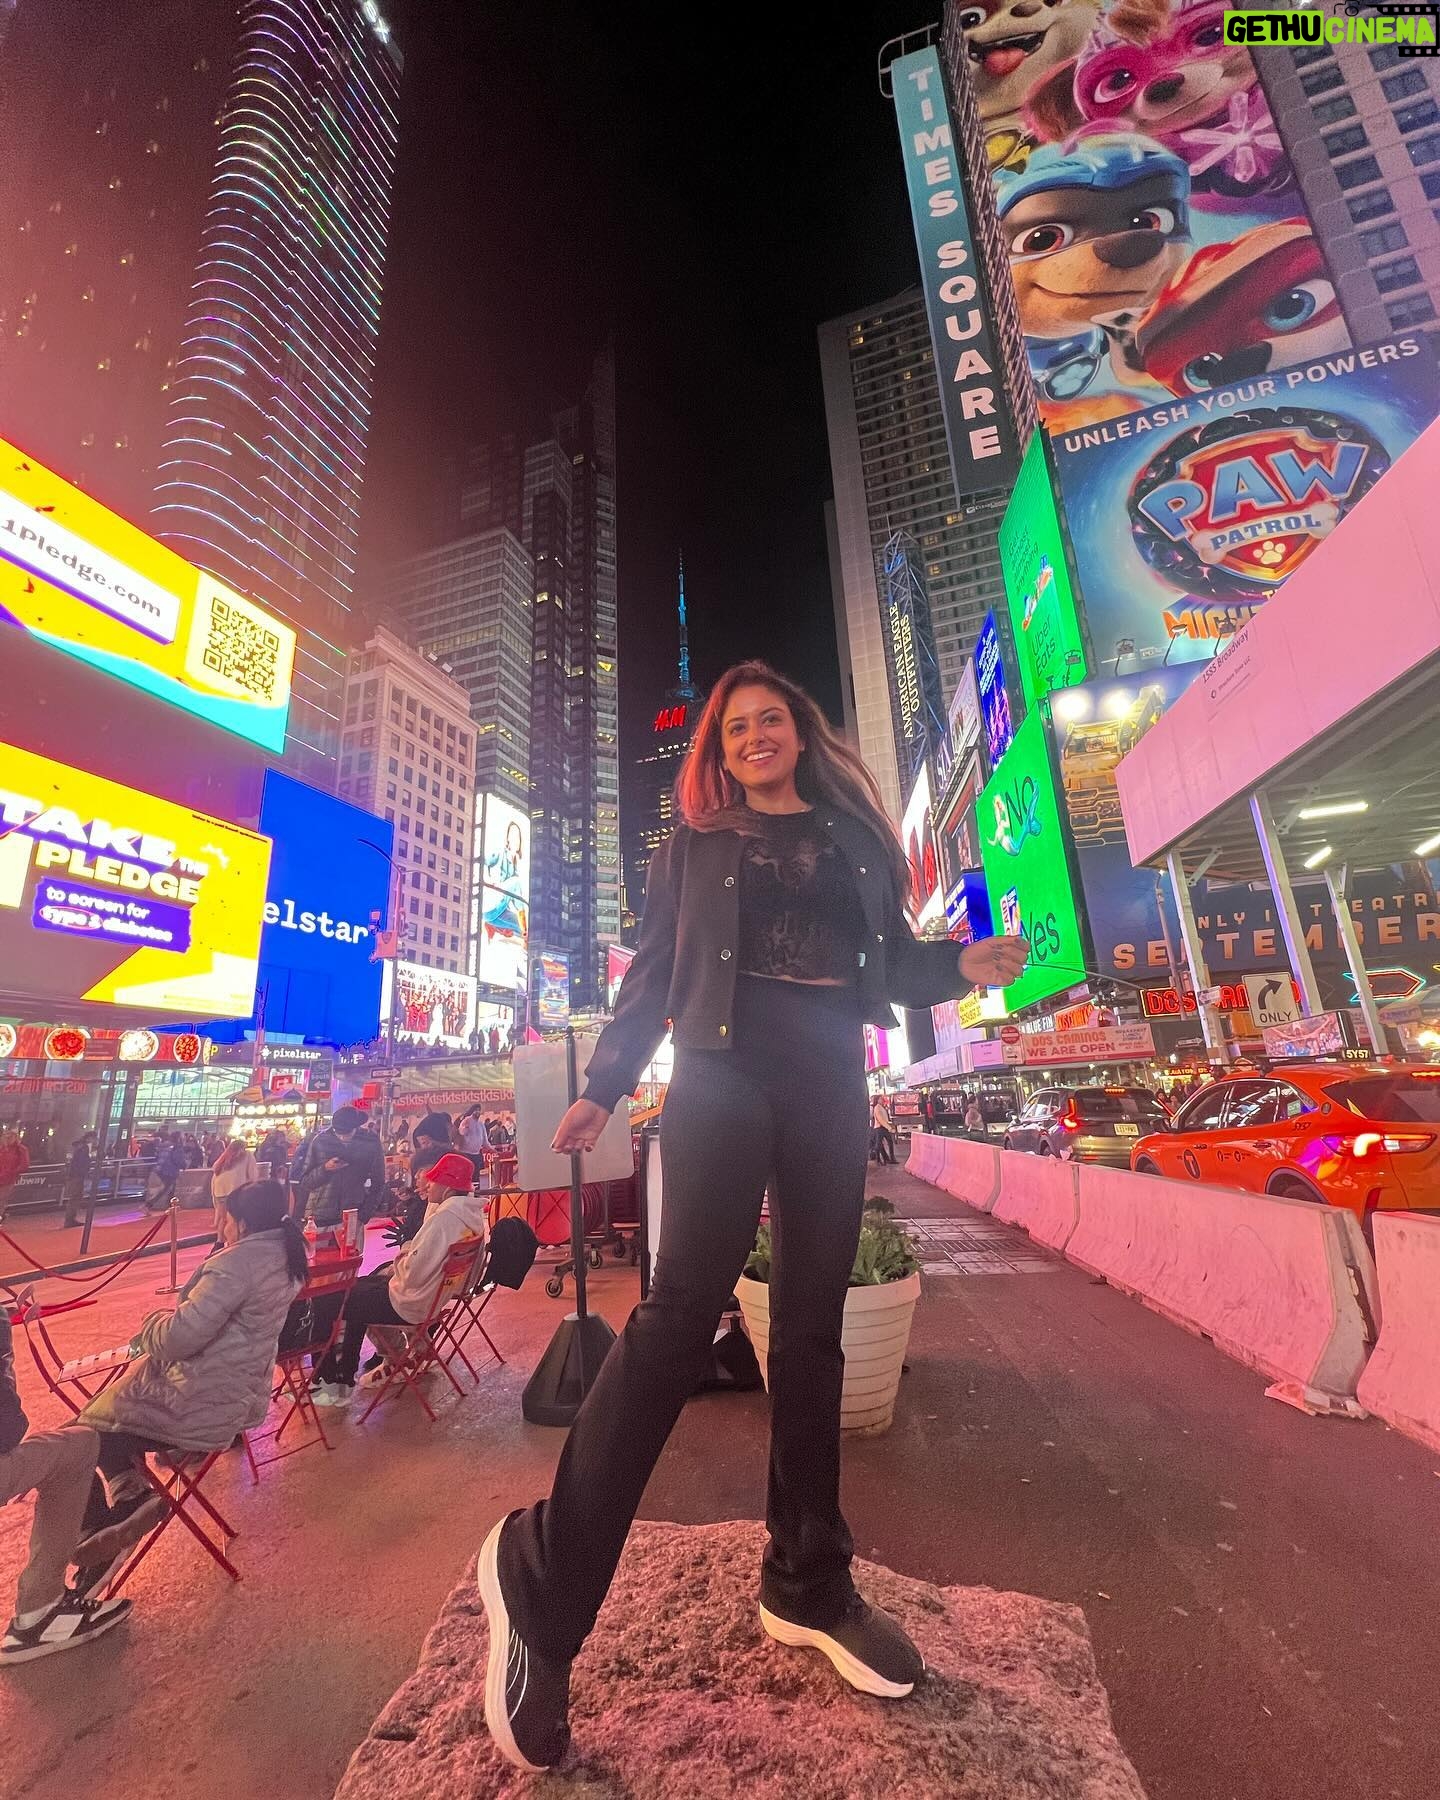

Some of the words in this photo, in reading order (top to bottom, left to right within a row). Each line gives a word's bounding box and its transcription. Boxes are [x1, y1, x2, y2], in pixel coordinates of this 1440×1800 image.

[908, 67, 958, 218] TIMES
[937, 240, 1002, 461] SQUARE
[1064, 404, 1190, 453] UNLEASH
[1198, 379, 1277, 413] YOUR
[1285, 339, 1421, 389] POWERS
[1137, 441, 1371, 542] PAW
[1209, 513, 1322, 551] PATROL
[890, 601, 902, 654] EAGLE
[1031, 614, 1051, 656] Uber
[901, 614, 920, 713] OUTFITTERS
[1035, 638, 1056, 677] Eats
[1216, 630, 1249, 668] Broadway
[896, 653, 914, 738] AMERICAN
[0, 790, 177, 868] TAKE
[34, 839, 202, 904] PLEDGE
[46, 886, 66, 902] to
[126, 903, 150, 919] for
[1197, 912, 1246, 929] NLY
[1021, 912, 1060, 966] Yes
[1259, 1011, 1292, 1024] ONLY
[273, 1047, 322, 1059] pixelstar
[1027, 1048, 1046, 1057] WE
[1051, 1044, 1077, 1056] ARE
[1080, 1042, 1116, 1053] OPEN
[1346, 1049, 1370, 1059] 5Y57
[15, 1176, 46, 1186] ubway
